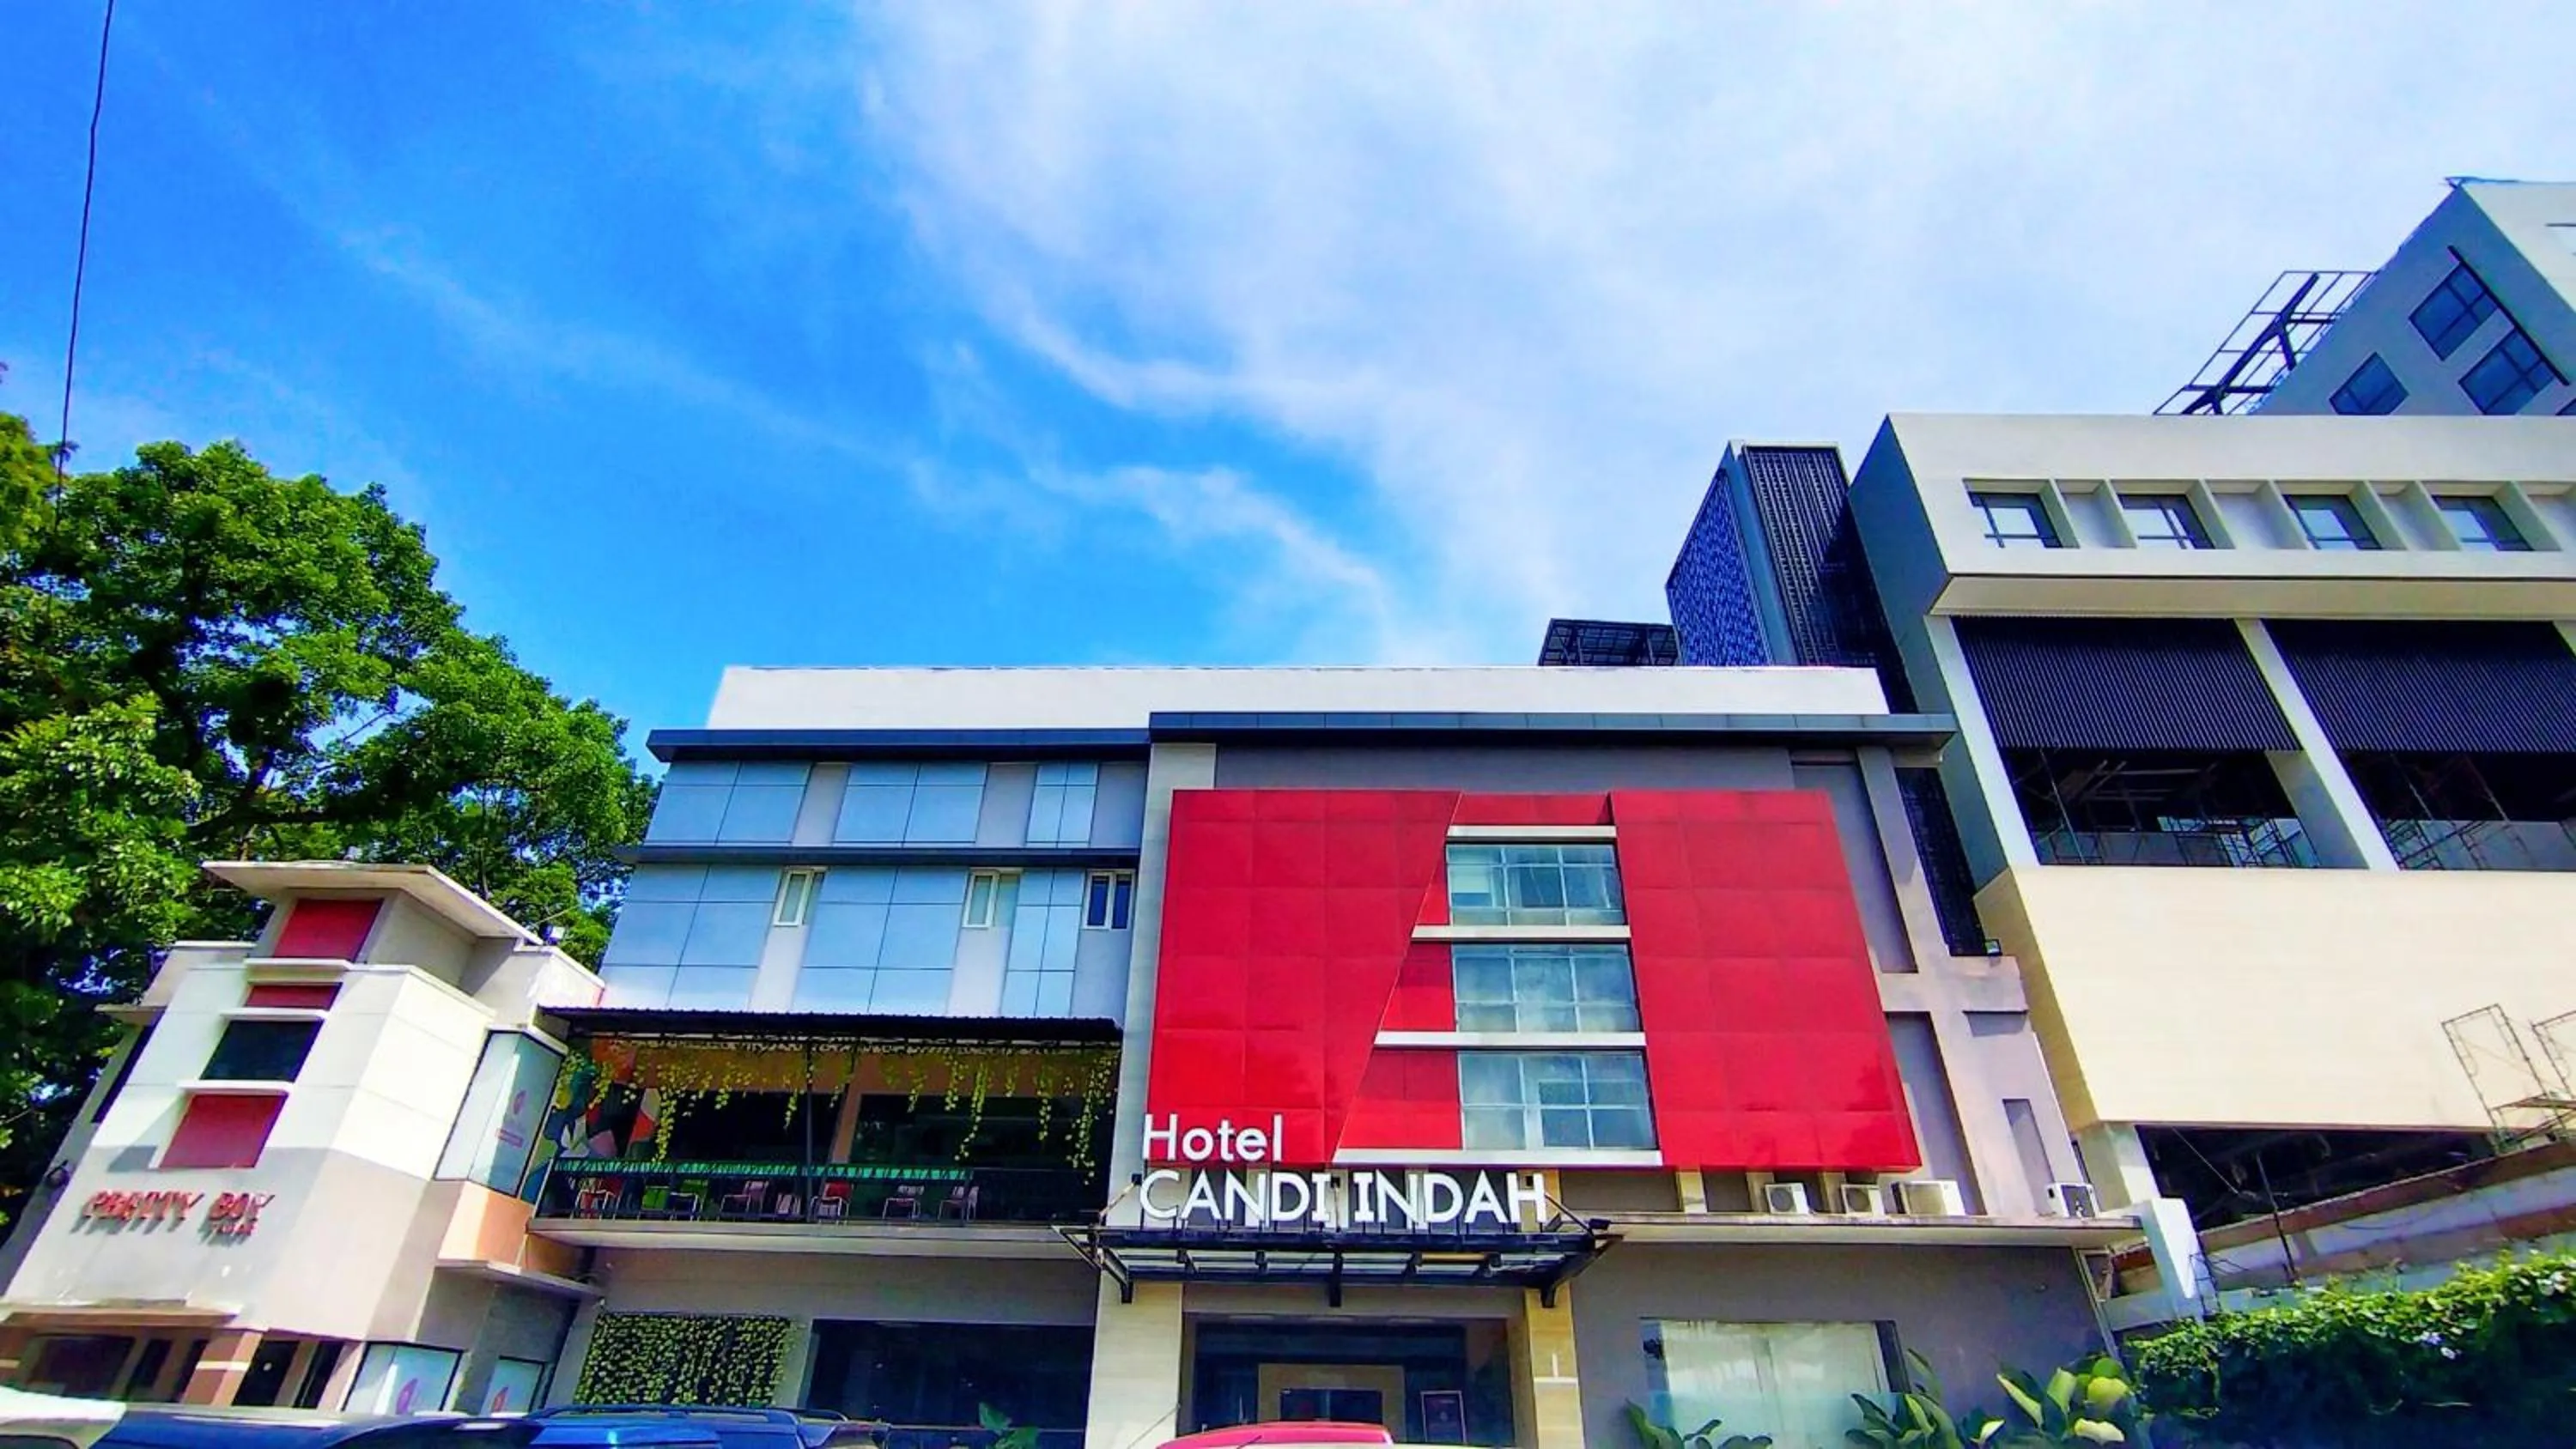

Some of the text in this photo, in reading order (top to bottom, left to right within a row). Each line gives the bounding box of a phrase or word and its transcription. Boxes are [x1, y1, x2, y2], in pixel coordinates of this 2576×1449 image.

[1143, 1113, 1283, 1161] Hotel
[209, 1191, 276, 1221] BOY
[1139, 1169, 1546, 1224] CANDI INDAH
